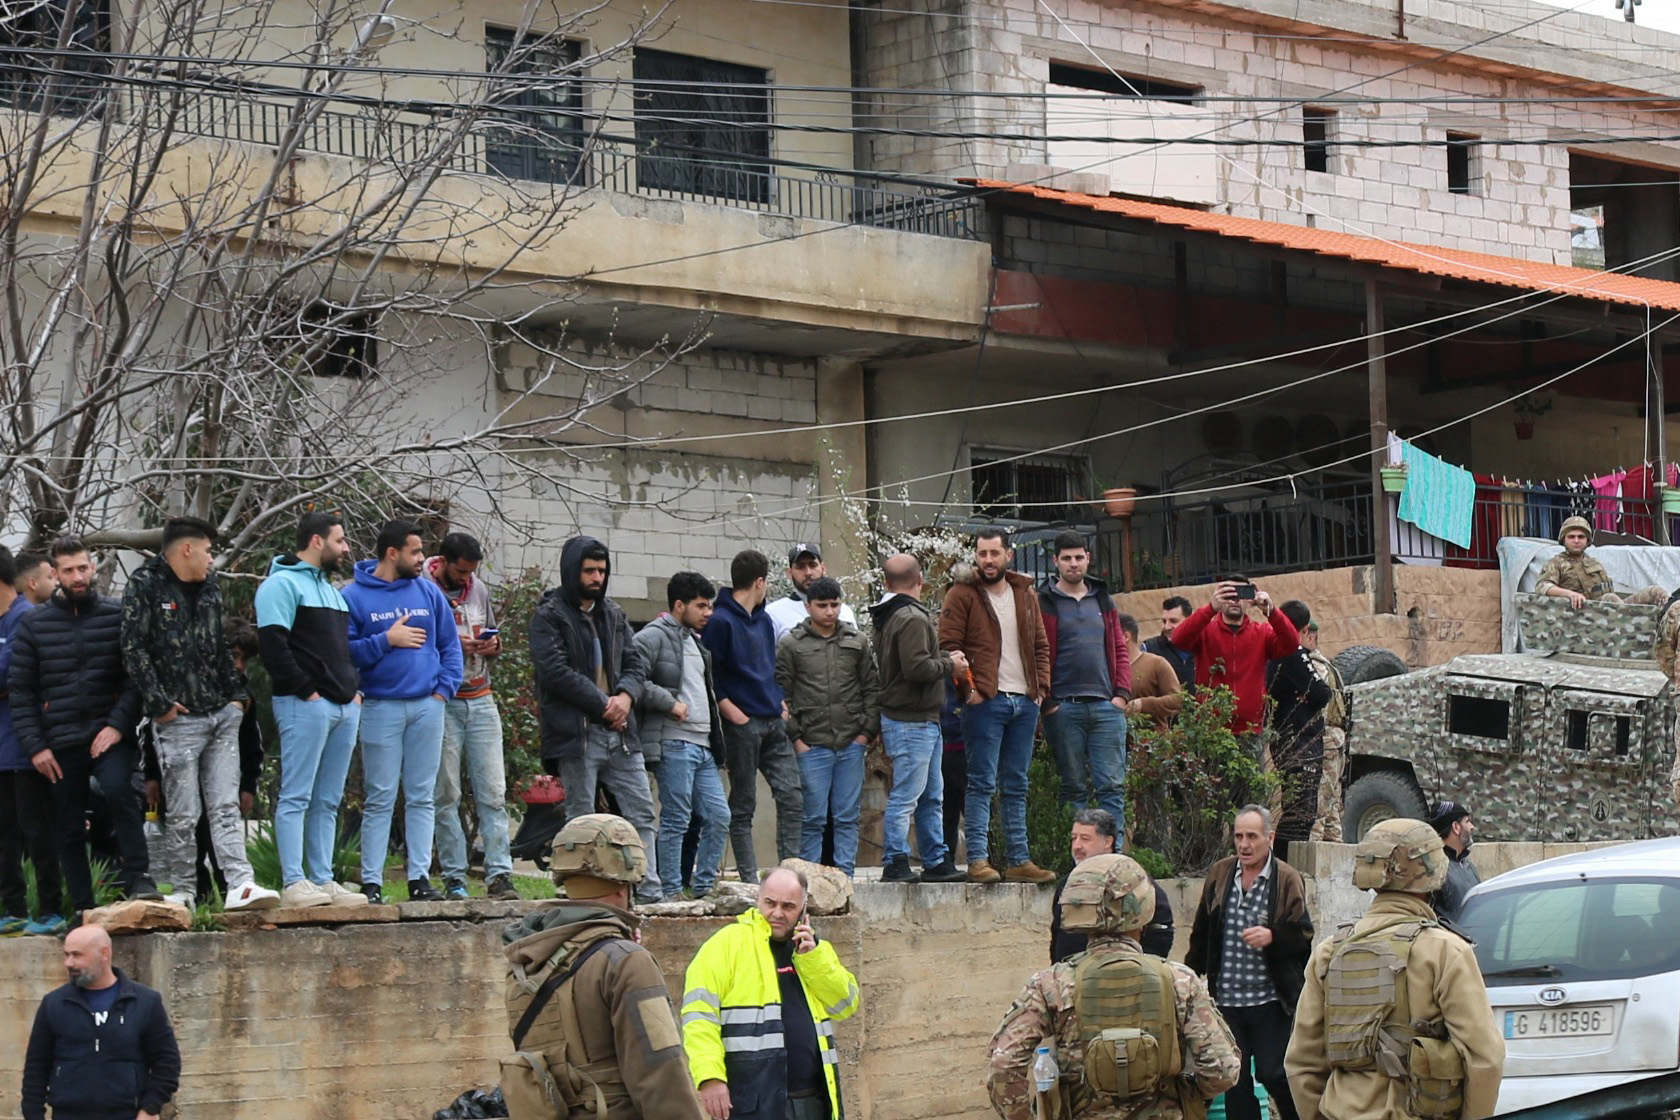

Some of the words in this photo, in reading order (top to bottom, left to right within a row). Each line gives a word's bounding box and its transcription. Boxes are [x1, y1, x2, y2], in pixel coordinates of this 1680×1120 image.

[371, 612, 394, 622] RALPH
[404, 608, 429, 617] LAUREN
[1543, 990, 1563, 1000] KIA
[1517, 1014, 1528, 1035] G
[1538, 1010, 1601, 1034] 418596
